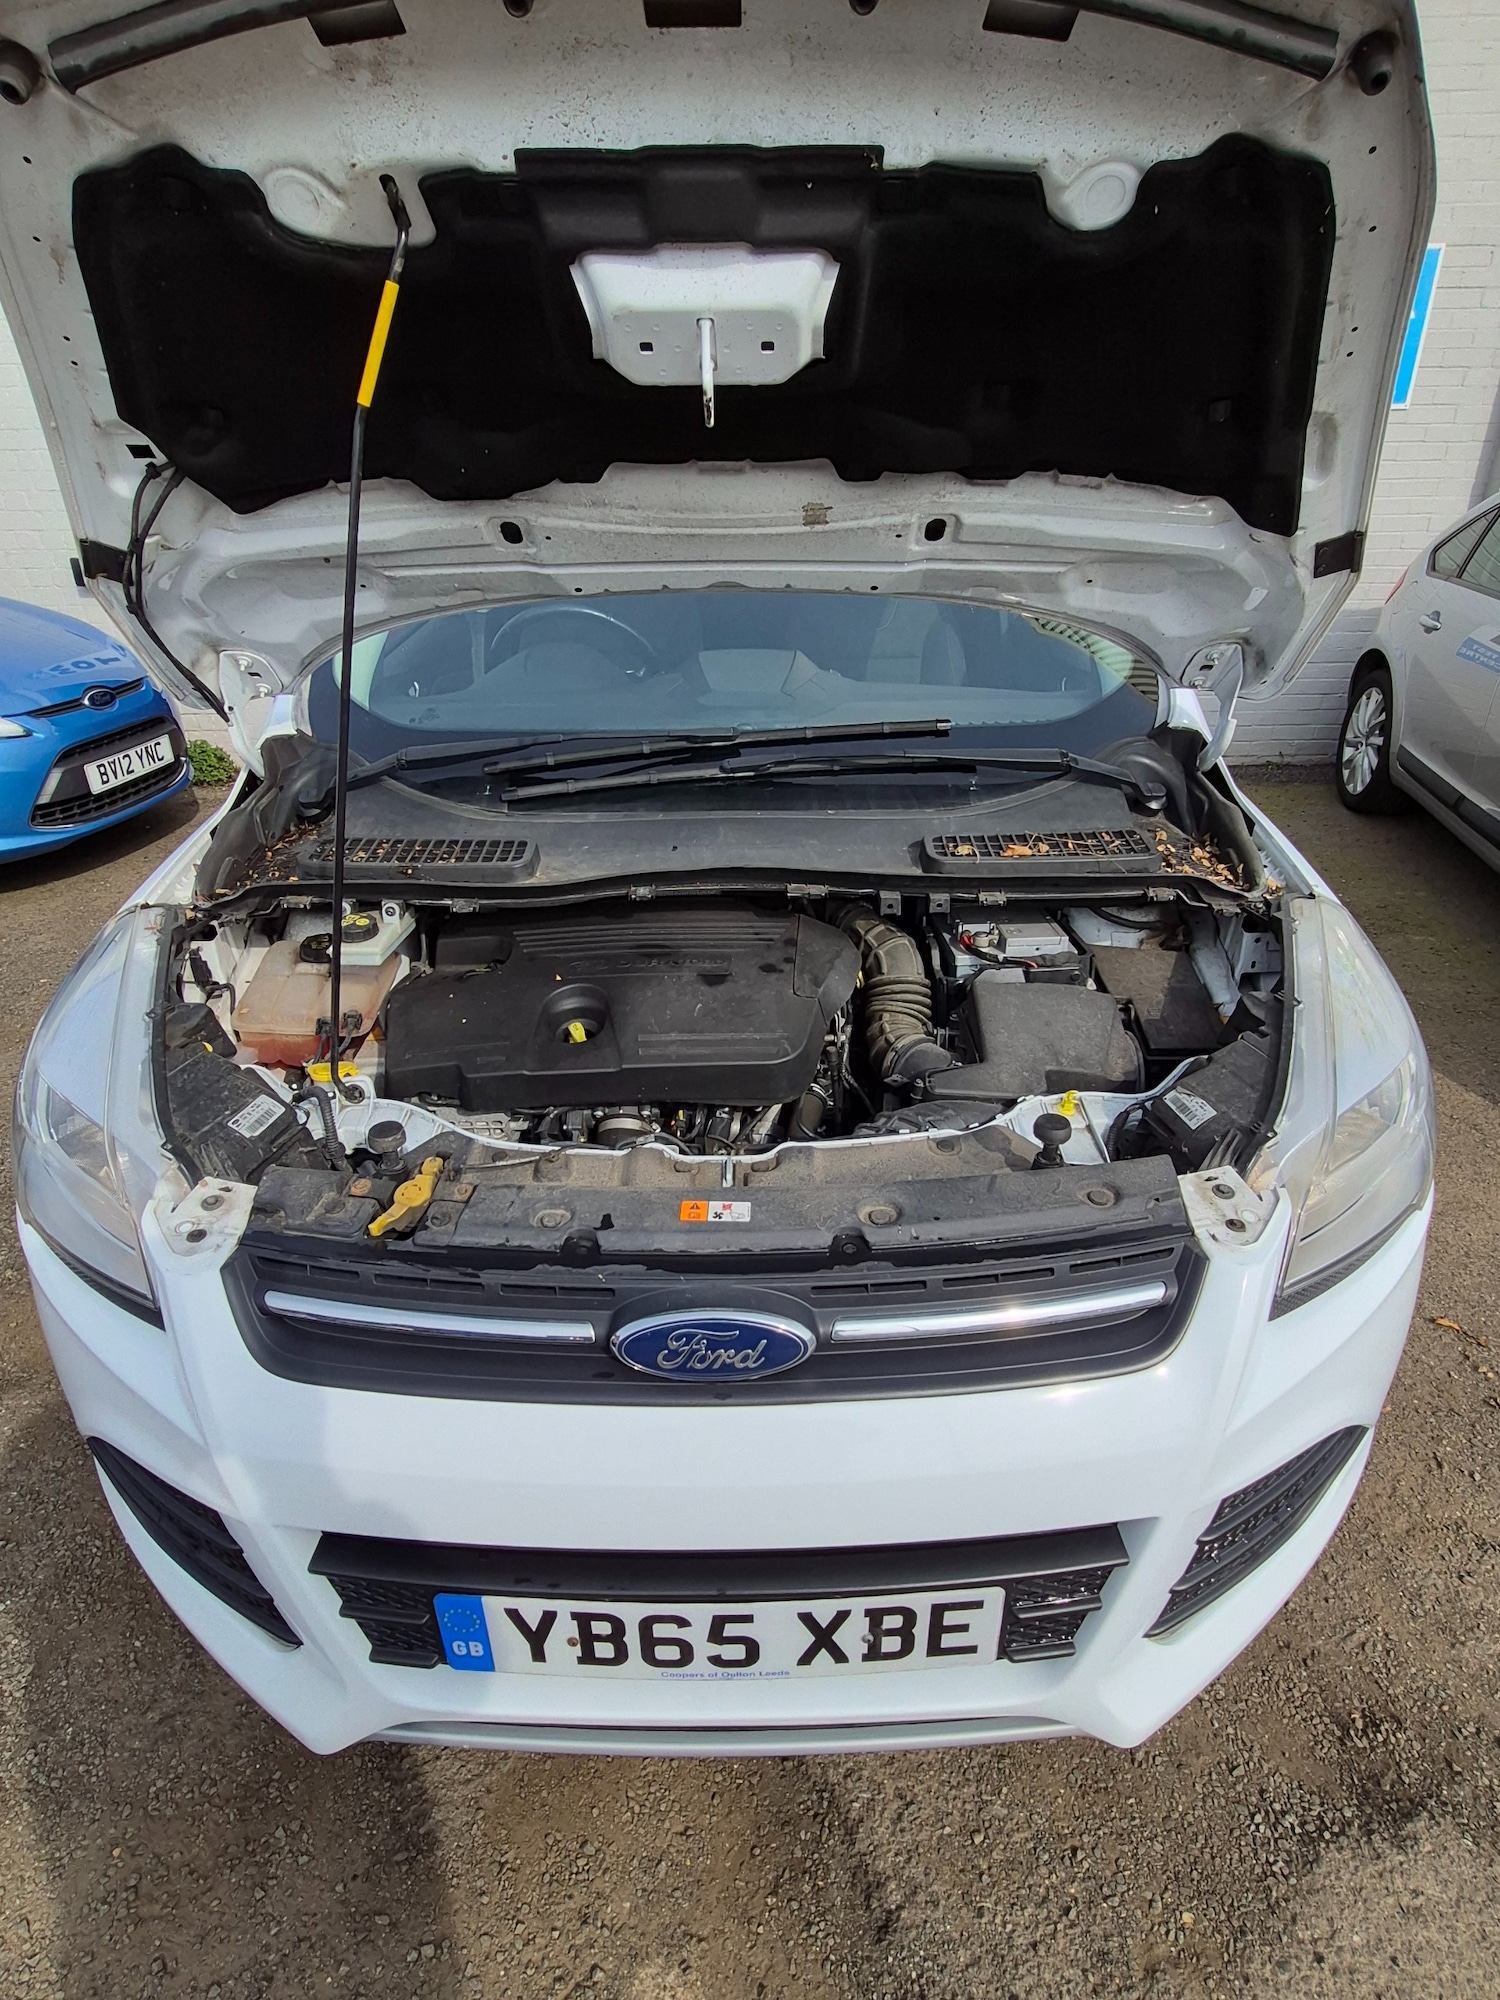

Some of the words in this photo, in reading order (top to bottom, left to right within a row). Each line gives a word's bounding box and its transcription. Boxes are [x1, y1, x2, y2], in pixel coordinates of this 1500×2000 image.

[96, 753, 135, 785] BV12
[135, 741, 165, 769] YNC
[656, 1328, 768, 1370] Ford
[451, 1640, 485, 1657] GB
[503, 1607, 761, 1669] YB65
[796, 1600, 985, 1666] XBE
[661, 1671, 705, 1679] Coopers
[721, 1671, 756, 1679] Oulton
